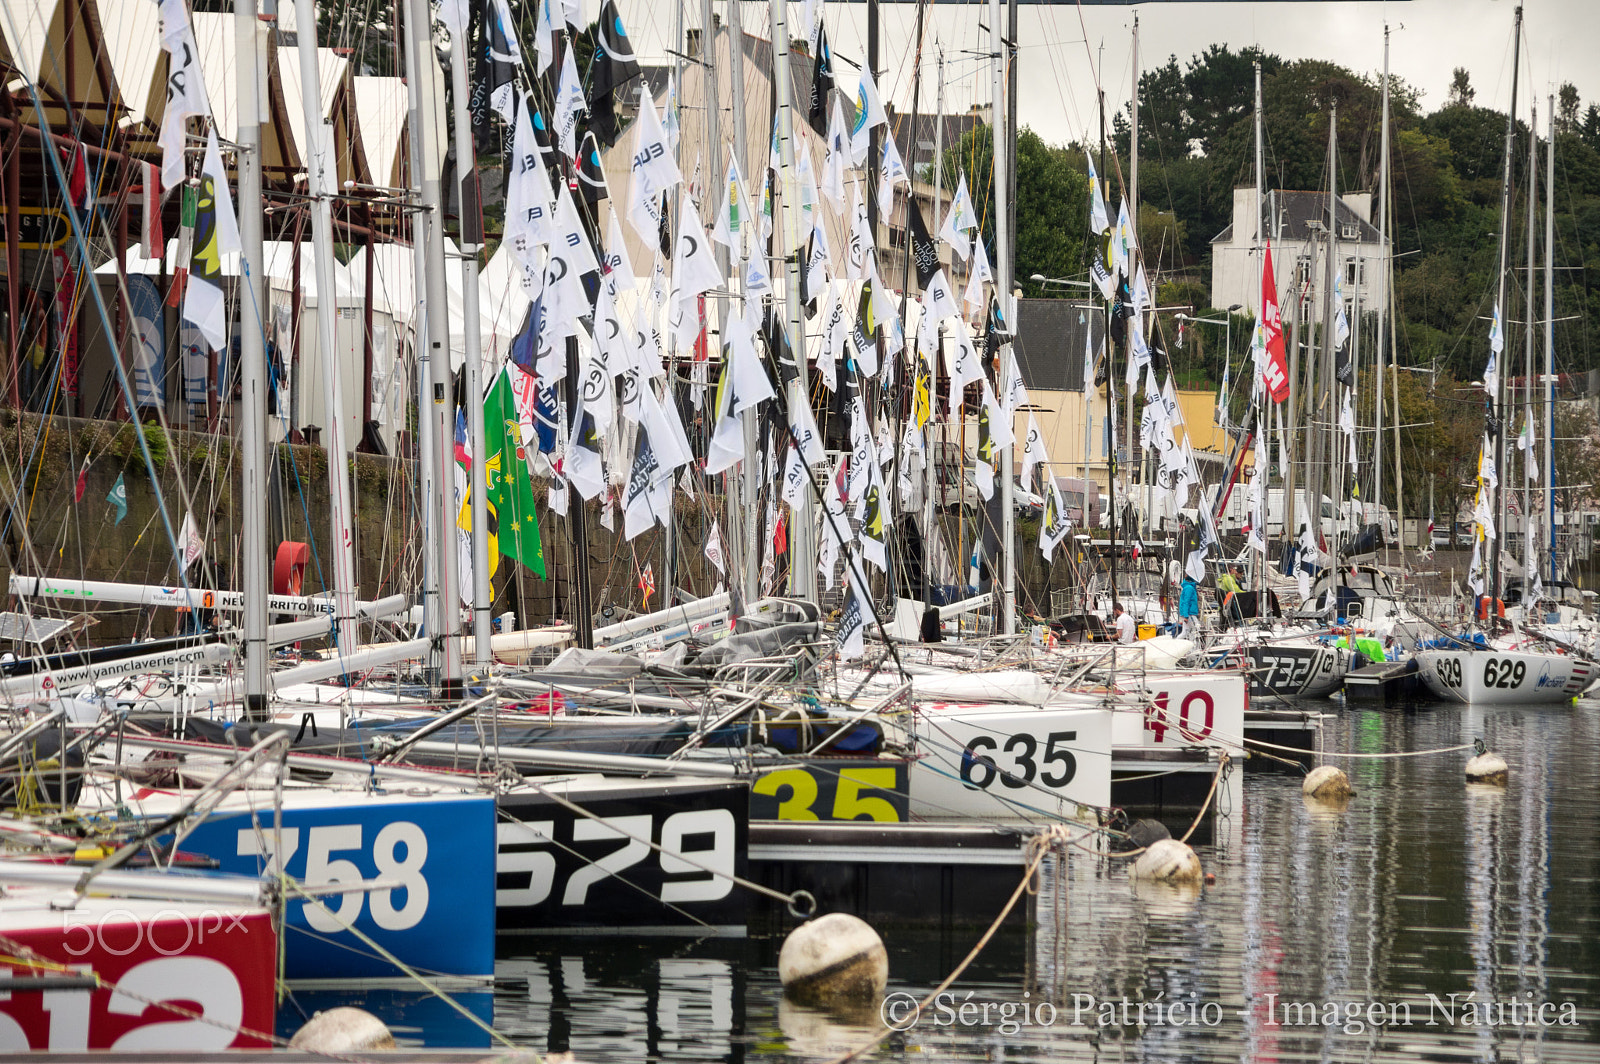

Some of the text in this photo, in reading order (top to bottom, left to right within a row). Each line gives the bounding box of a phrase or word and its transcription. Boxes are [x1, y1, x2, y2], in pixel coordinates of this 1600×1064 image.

[56, 650, 206, 684] wwwyannclaverie.com
[1262, 656, 1311, 688] 732
[1436, 658, 1463, 688] 629
[1483, 657, 1526, 689] 629
[960, 731, 1078, 791] 635
[236, 821, 429, 933] 758
